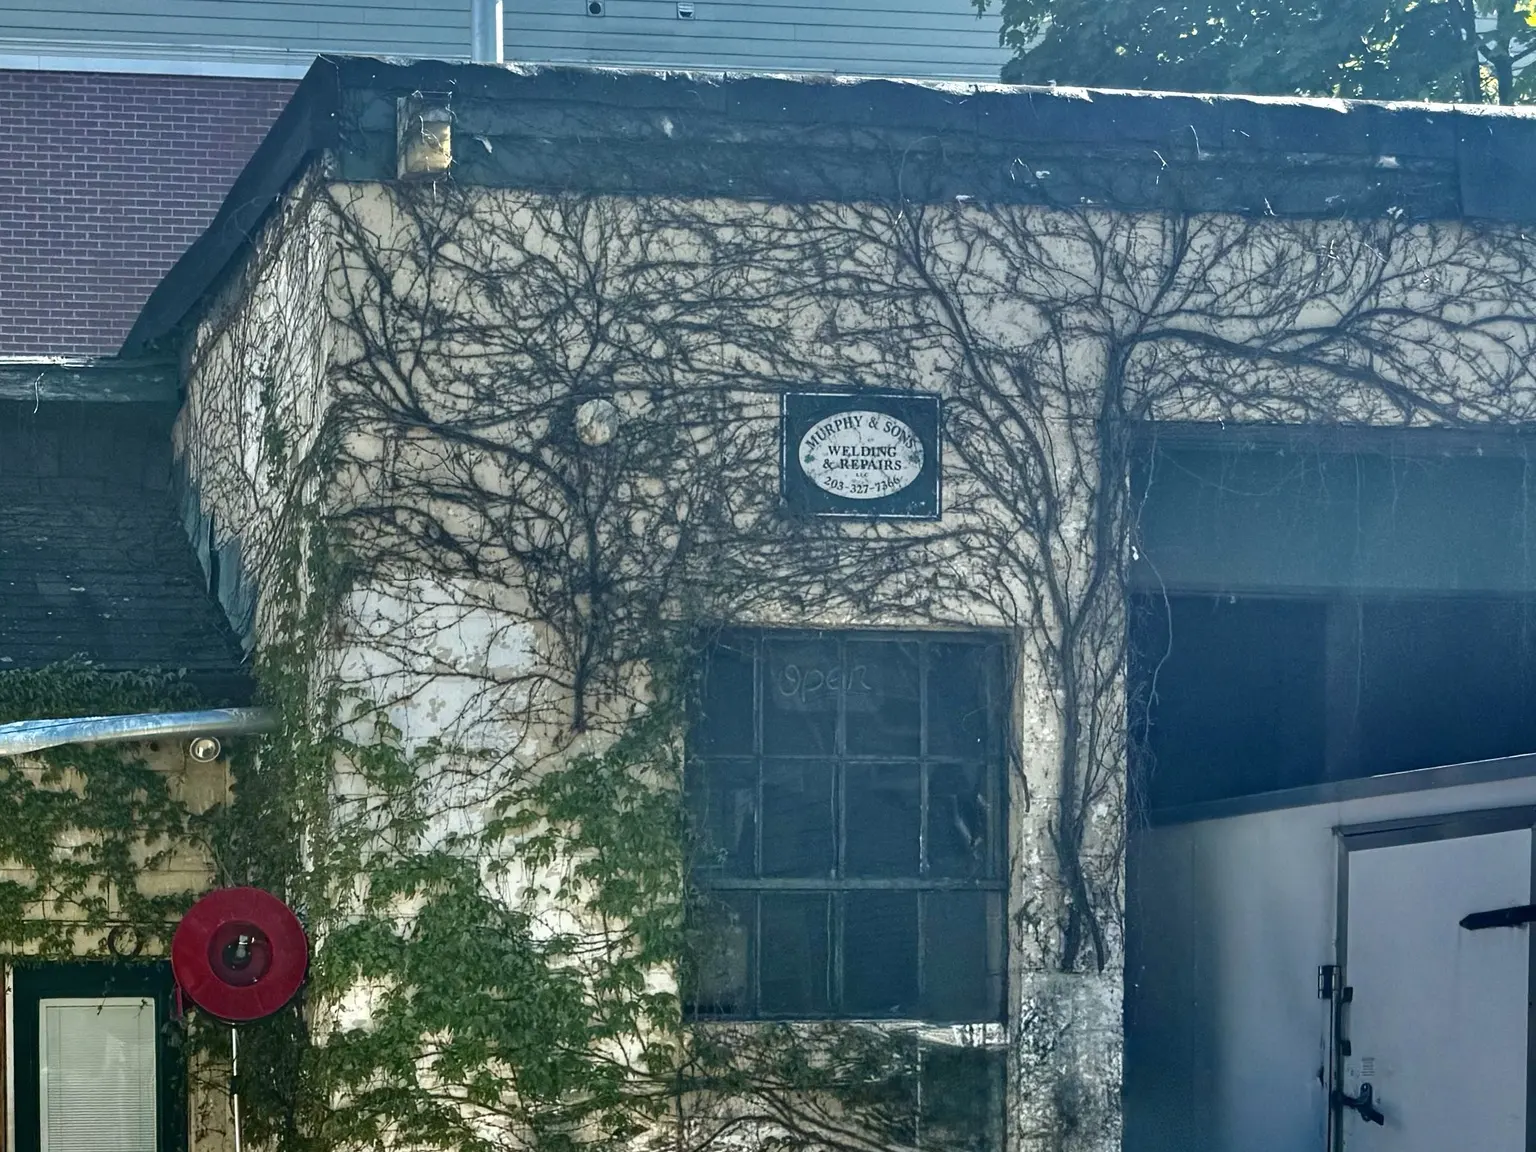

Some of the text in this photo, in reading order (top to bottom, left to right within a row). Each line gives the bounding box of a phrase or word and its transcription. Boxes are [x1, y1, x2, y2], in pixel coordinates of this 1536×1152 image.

[805, 415, 914, 450] MURPHY & SONS
[828, 445, 897, 457] WELDING
[822, 458, 902, 471] & REPAIRS
